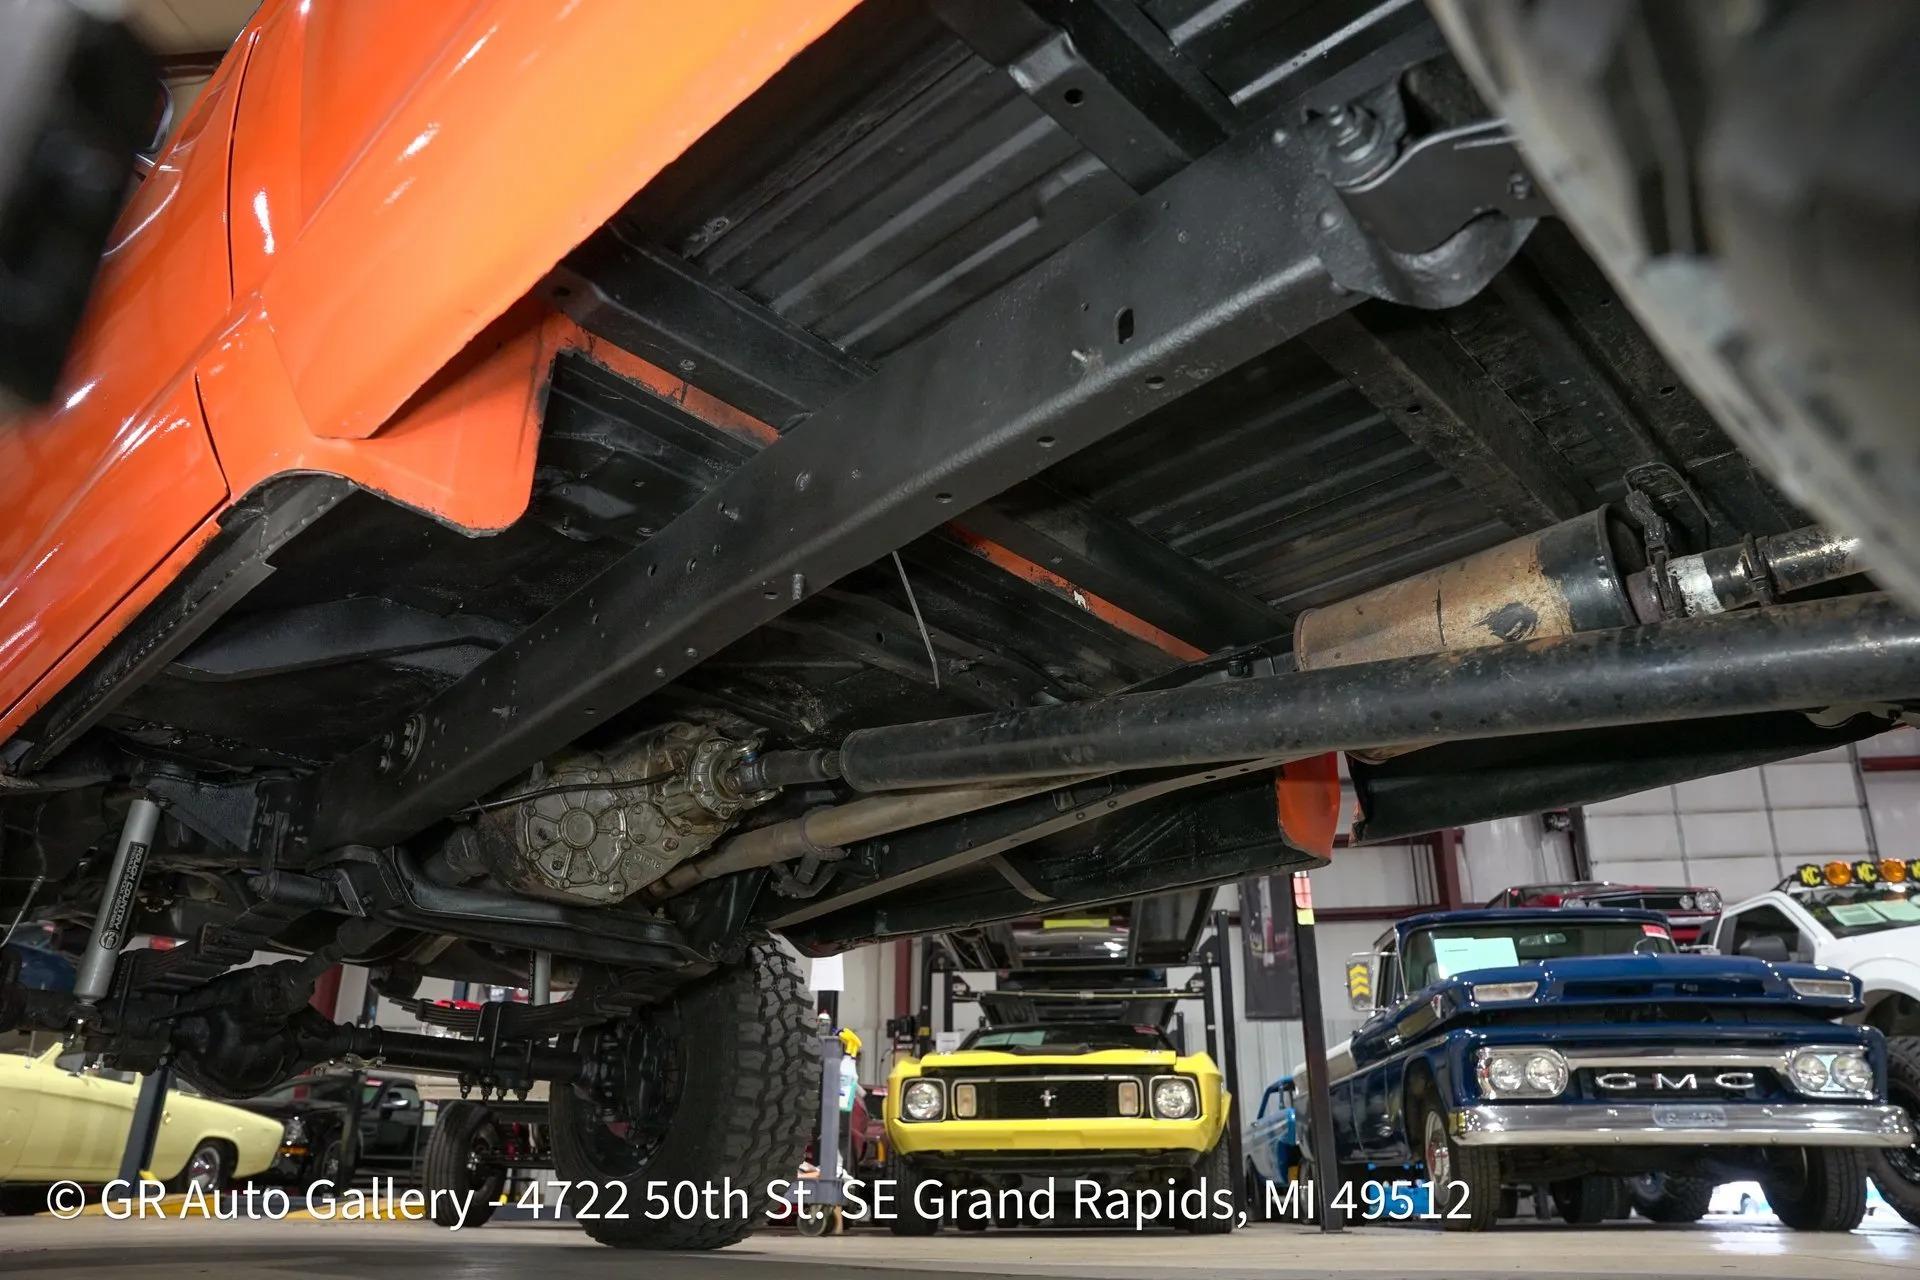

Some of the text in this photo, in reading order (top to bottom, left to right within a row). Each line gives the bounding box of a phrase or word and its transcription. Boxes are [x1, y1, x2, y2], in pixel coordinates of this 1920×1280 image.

[1801, 866, 1822, 885] KC
[1856, 862, 1878, 882] KC
[114, 846, 144, 930] ROUGH COUNTRY
[1595, 1072, 1755, 1089] GMC
